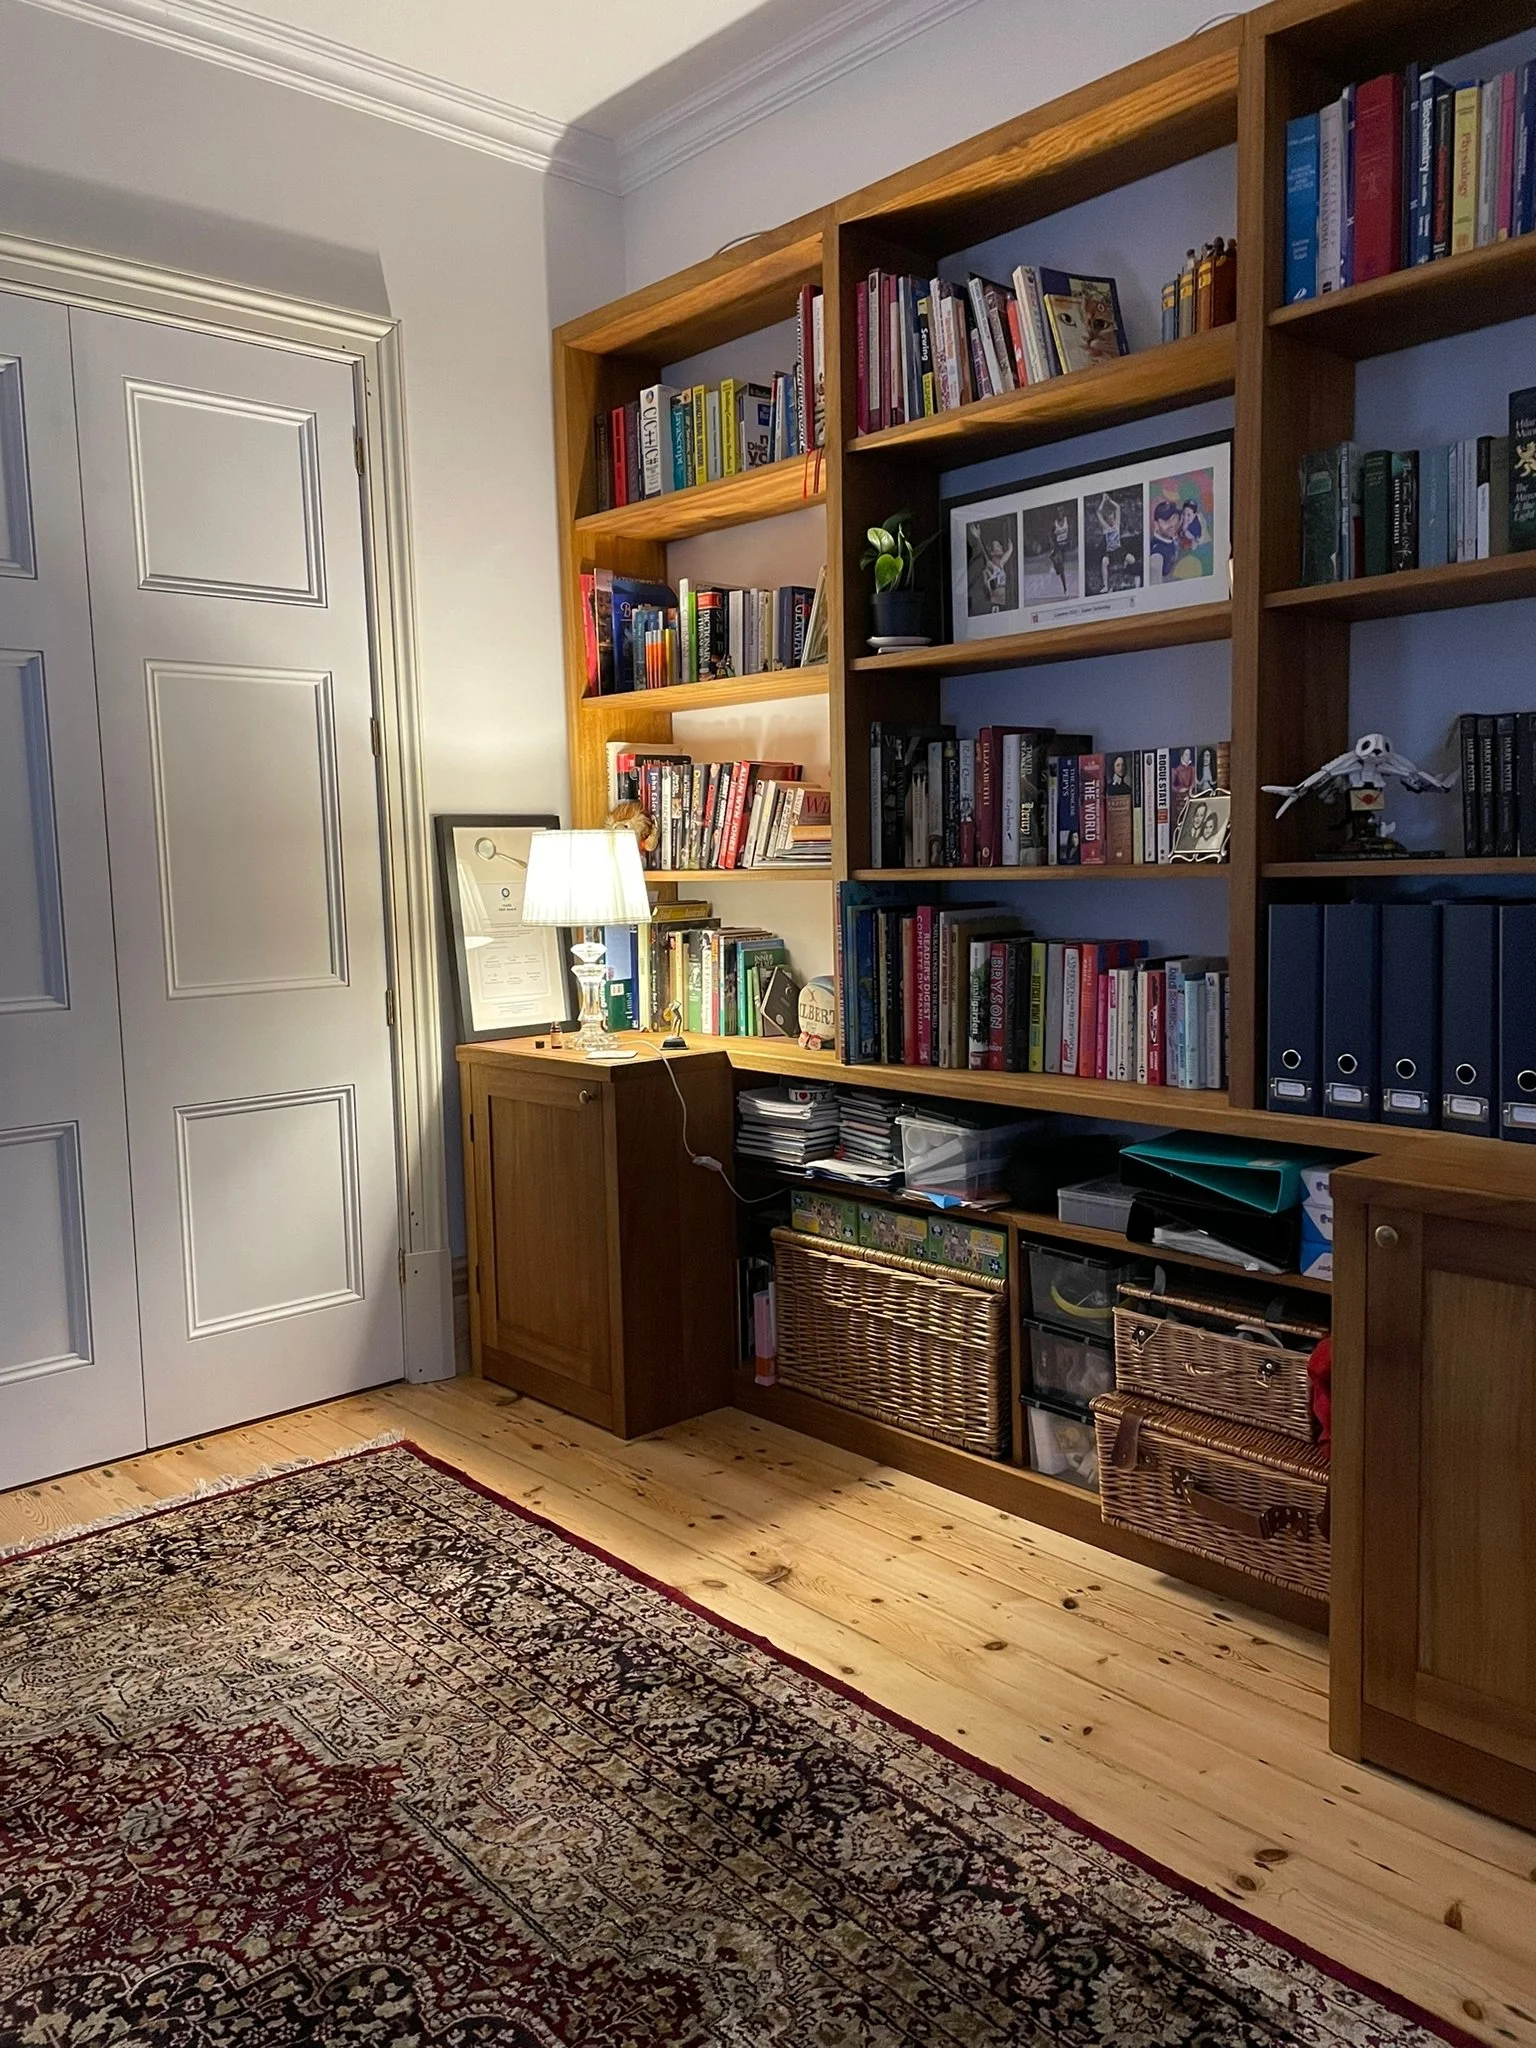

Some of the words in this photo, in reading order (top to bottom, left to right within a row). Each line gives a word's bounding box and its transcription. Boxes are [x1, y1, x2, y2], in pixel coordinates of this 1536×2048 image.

[1420, 98, 1432, 172] Biochemistry
[1321, 141, 1330, 186] HUMAN
[1459, 132, 1472, 198] Physiology
[1320, 191, 1329, 250] ANATOMY
[921, 328, 930, 361] Sewing
[643, 407, 659, 465] C/C++/C#
[675, 411, 683, 464] JavaScript
[1396, 536, 1413, 558] Wife
[794, 604, 804, 661] GERMAN
[1466, 738, 1475, 763] HARRY
[1484, 738, 1492, 763] HARRY
[1504, 736, 1512, 762] HARRY
[650, 772, 658, 790] John
[737, 766, 747, 794] ALUN
[948, 760, 956, 792] Catherine
[961, 768, 970, 791] Queen
[1158, 754, 1167, 782] ROGUE
[1467, 764, 1475, 792] POTTER
[1484, 765, 1492, 794] POTTER
[1504, 764, 1512, 792] POTTER
[1085, 780, 1095, 800] THE
[1159, 783, 1167, 807] STATE
[734, 796, 742, 819] WYN
[728, 820, 738, 852] JONES
[1084, 804, 1096, 841] WORLD
[1032, 975, 1041, 1003] DIFFICULT
[1169, 967, 1177, 989] bad
[990, 956, 1003, 1029] BRYSON
[1032, 1004, 1040, 1024] WOMEN
[1169, 990, 1177, 1031] science
[795, 1092, 798, 1100] I
